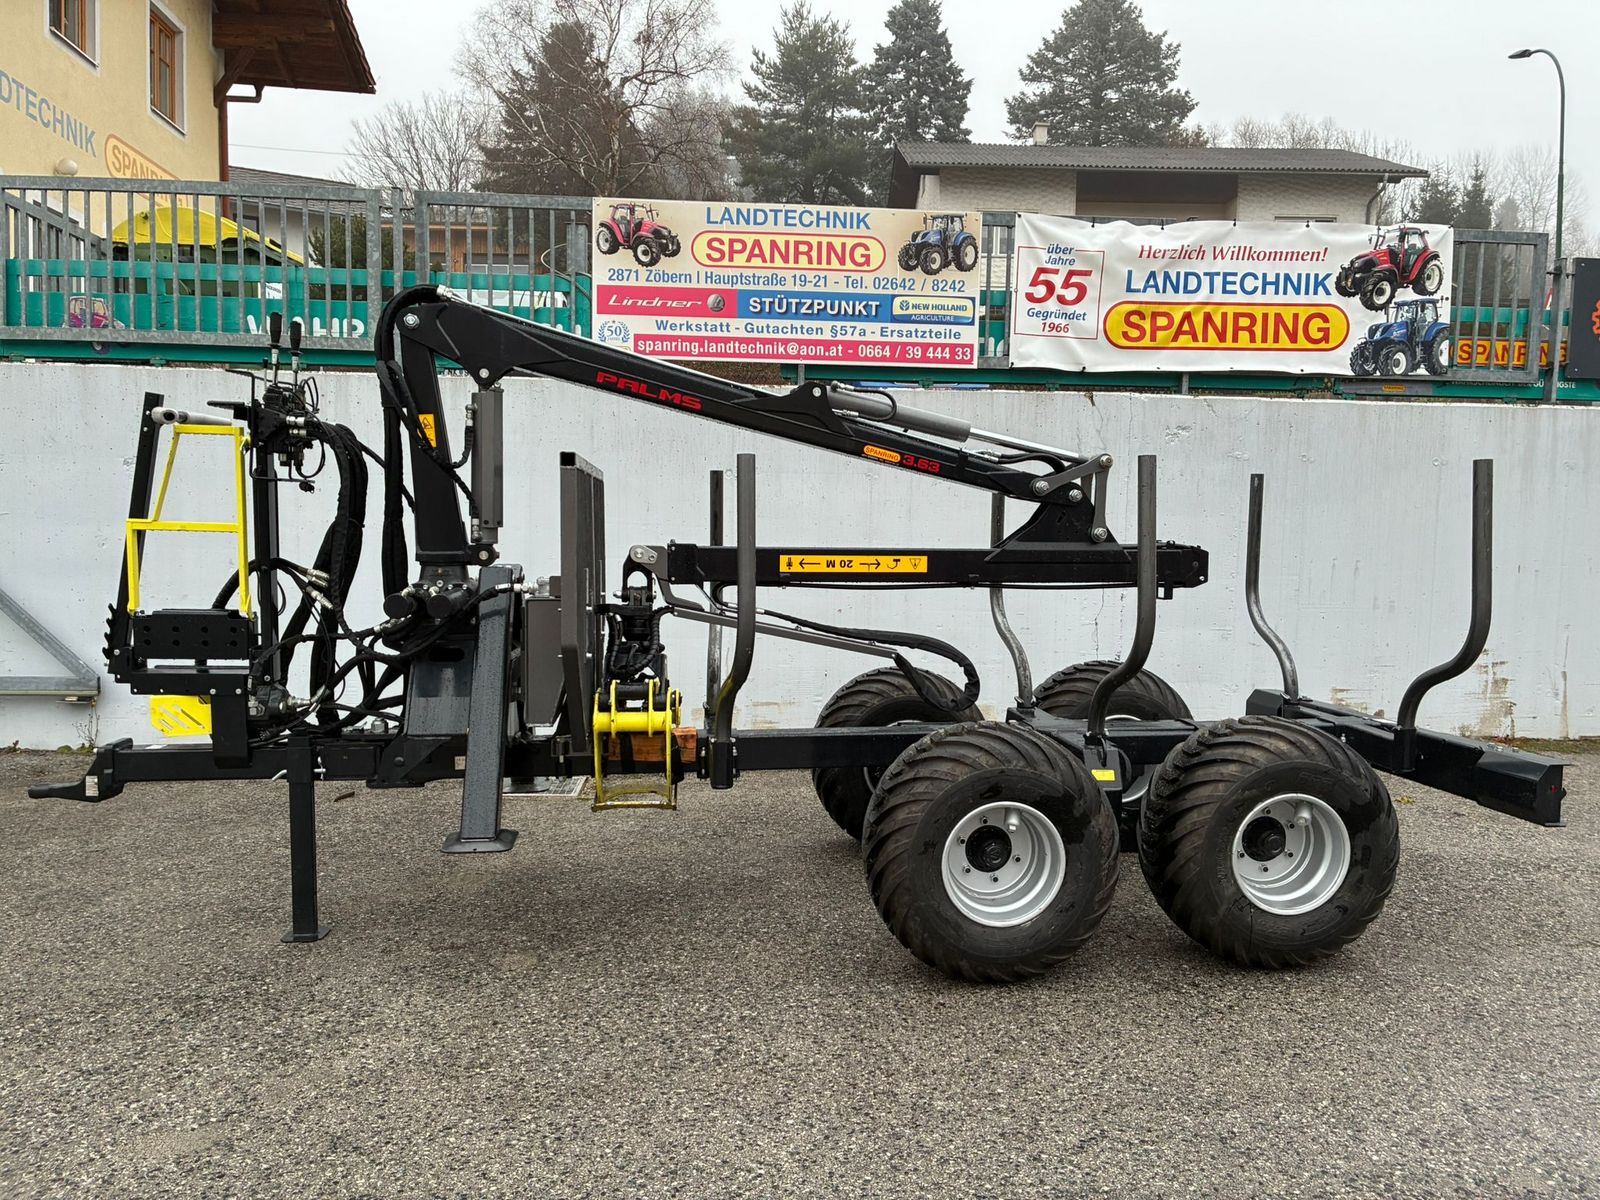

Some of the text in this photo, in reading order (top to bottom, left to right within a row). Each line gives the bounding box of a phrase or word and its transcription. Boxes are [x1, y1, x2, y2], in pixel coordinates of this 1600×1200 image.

[706, 206, 871, 230] LANDTECHNIK
[705, 237, 871, 267] SPANRING
[1047, 244, 1074, 255] über
[1138, 244, 1328, 262] Herzlich Willkommen!
[1045, 256, 1076, 266] Jahre
[608, 268, 639, 282] 2871
[645, 269, 692, 283] Zöbern
[704, 271, 787, 288] Hauptstraße
[792, 273, 828, 288] 19-21
[844, 275, 868, 289] Tel.
[873, 277, 916, 291] 02642
[931, 279, 966, 292] 8242
[1025, 267, 1093, 306] 55
[1125, 269, 1333, 296] LANDTECHNIK
[608, 294, 703, 308] Lindner
[749, 294, 880, 317] STÜTZPUNKT
[911, 302, 968, 312] NEW HOLLAND
[910, 314, 955, 322] AGRICULTURE
[1027, 307, 1088, 322] Gegründet
[606, 325, 622, 337] 50
[655, 319, 731, 333] Werkstatt
[744, 322, 824, 336] Gutachten
[830, 324, 866, 338] §57a
[880, 326, 961, 340] Ersatzteile
[1041, 322, 1070, 334] 1966
[1121, 309, 1331, 345] SPANRING
[637, 338, 843, 357] spanring.landtechnik@aon.at
[858, 344, 891, 358] 0664
[905, 345, 922, 359] 39
[926, 346, 951, 359] 444
[955, 347, 971, 360] 33
[596, 371, 704, 410] PALMS
[865, 446, 899, 462] SPANRING
[903, 454, 941, 473] 3.63
[826, 559, 853, 568] 20 M
